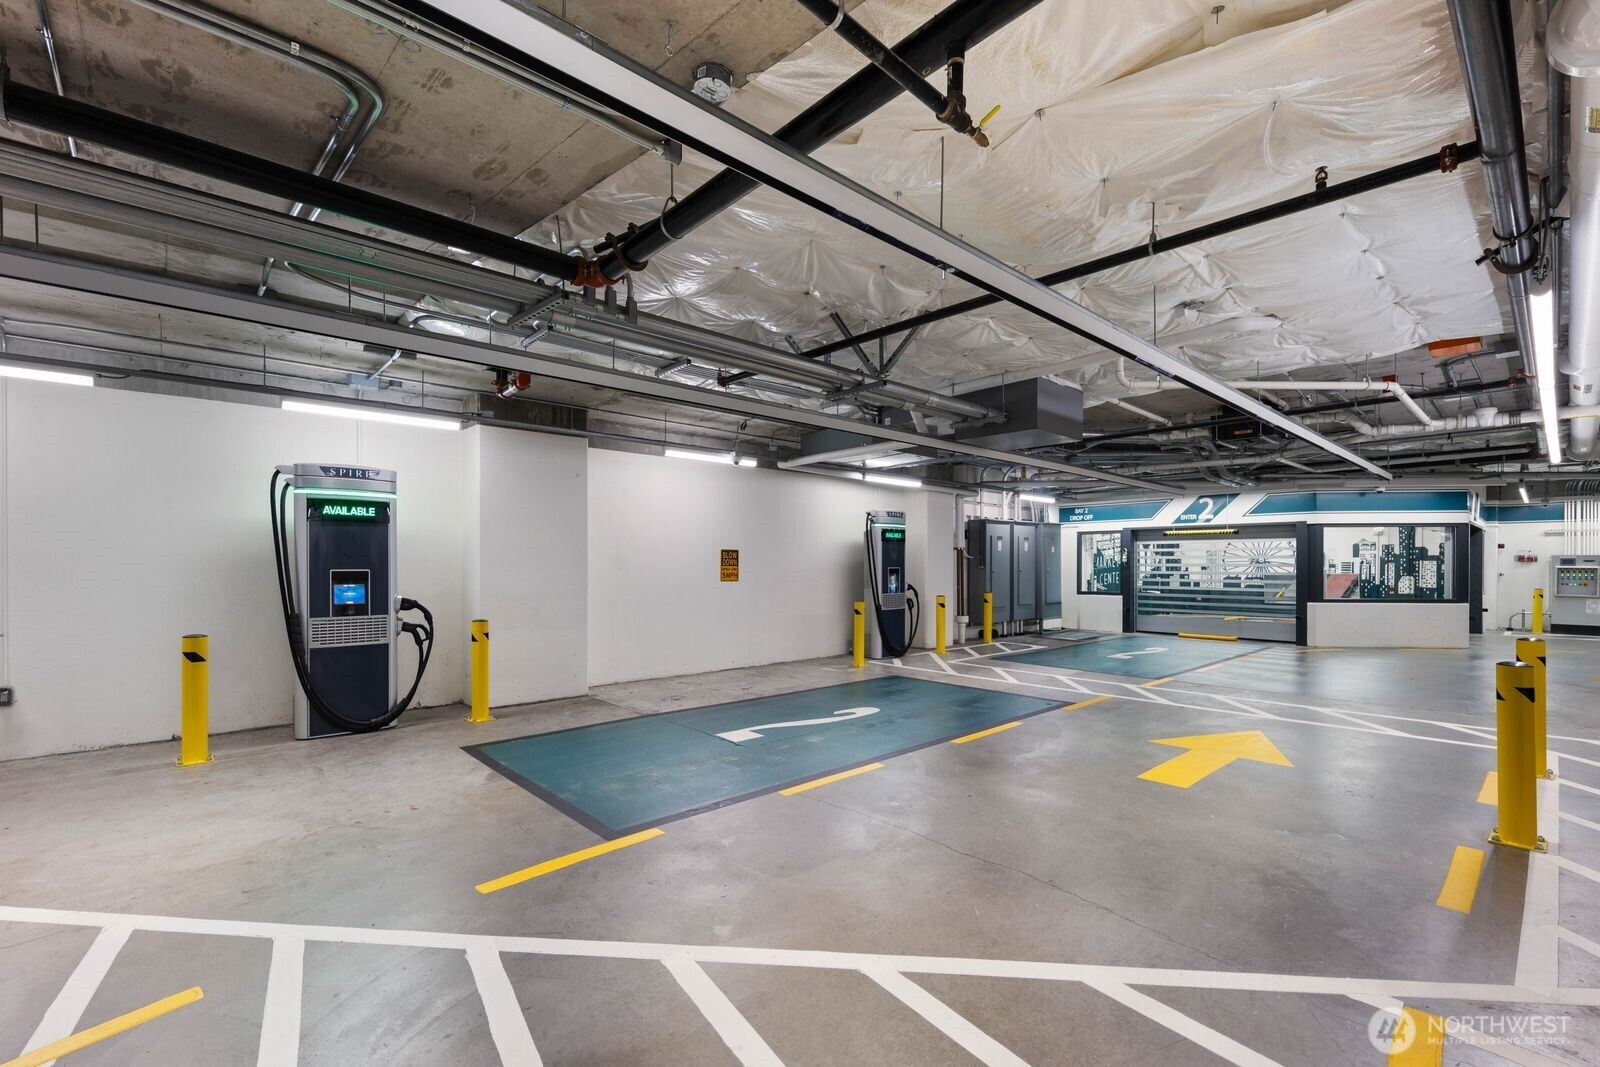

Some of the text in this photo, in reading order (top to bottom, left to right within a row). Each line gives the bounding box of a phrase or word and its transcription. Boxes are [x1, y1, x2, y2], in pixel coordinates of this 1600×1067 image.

[323, 505, 376, 517] AVAILABLE
[1099, 571, 1120, 585] CENTE
[715, 706, 881, 743] 2
